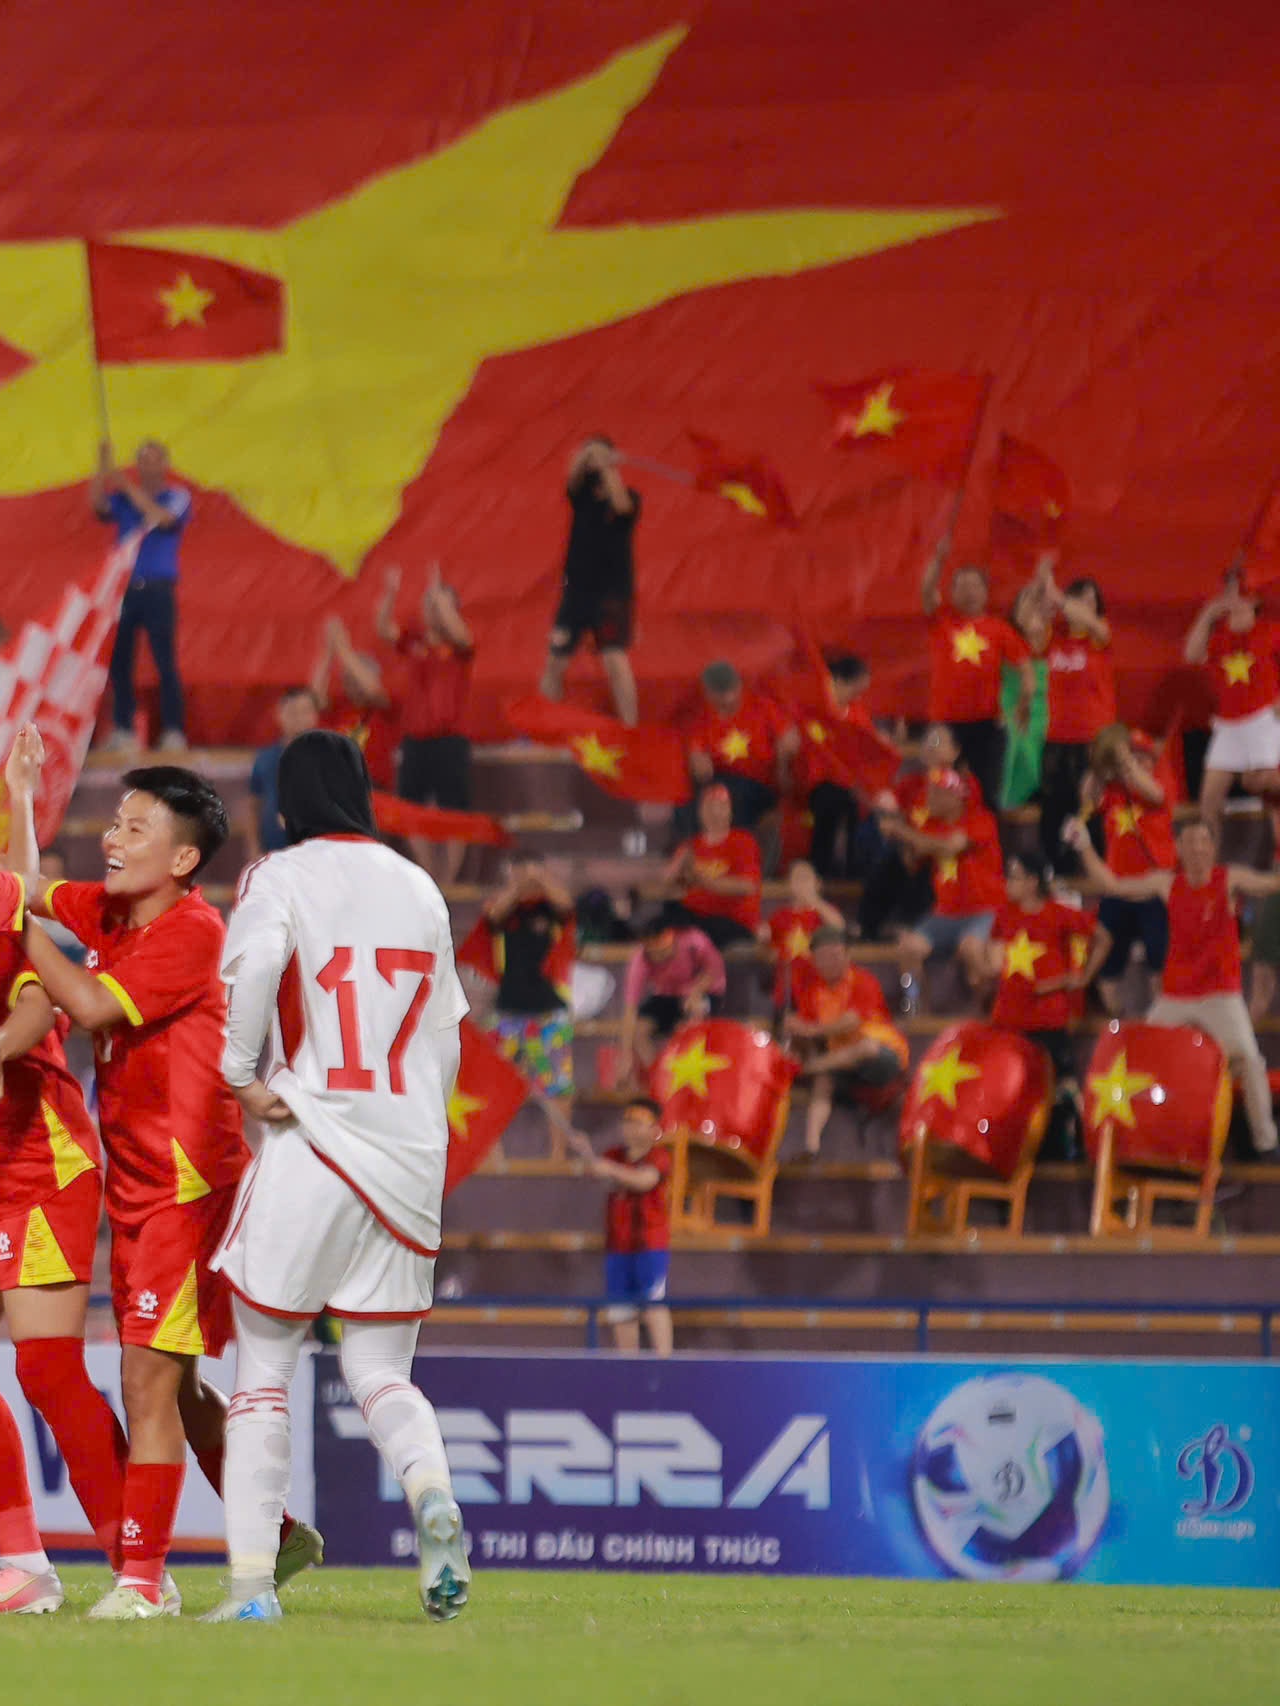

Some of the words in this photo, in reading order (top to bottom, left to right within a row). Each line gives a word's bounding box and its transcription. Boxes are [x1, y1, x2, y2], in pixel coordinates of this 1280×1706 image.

[316, 946, 437, 1096] 17
[481, 1530, 528, 1560] THI
[602, 1531, 696, 1564] CHÍNH
